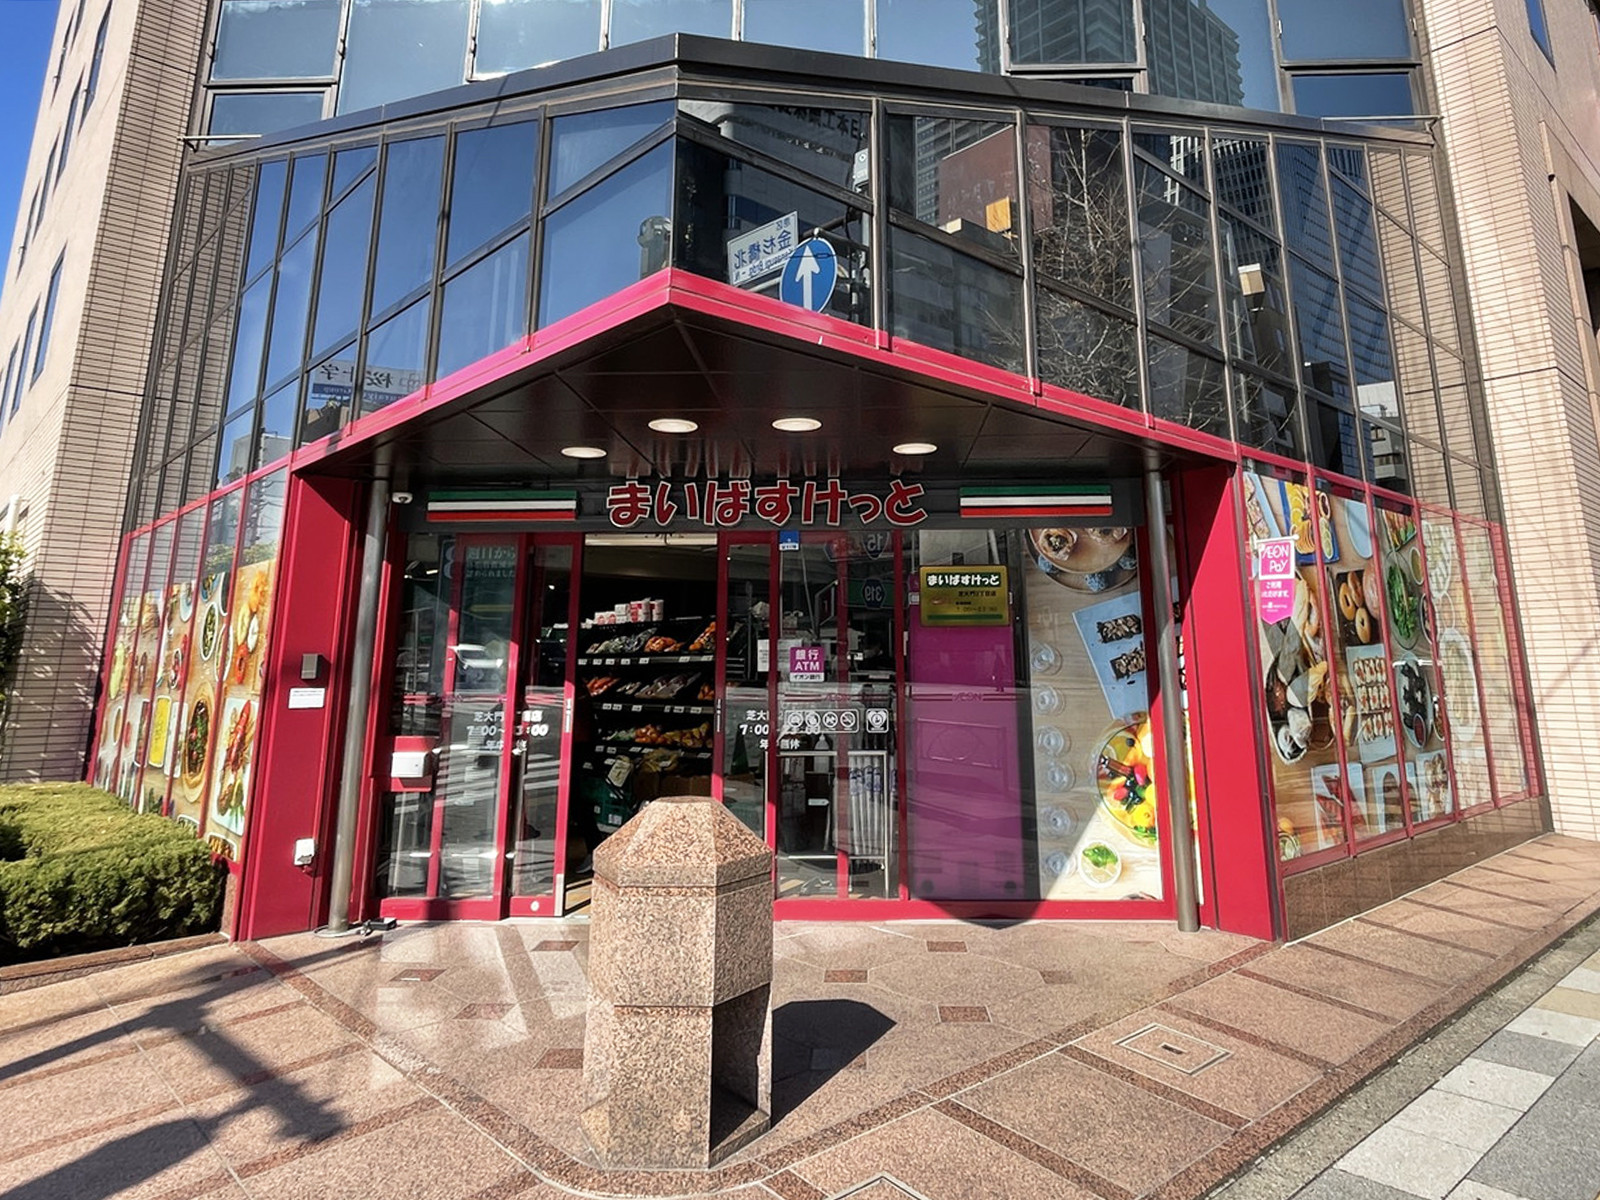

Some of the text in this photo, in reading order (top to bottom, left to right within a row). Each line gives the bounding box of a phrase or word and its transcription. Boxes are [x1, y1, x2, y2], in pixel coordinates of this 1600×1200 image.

[606, 479, 928, 528] まいばすけっと
[927, 574, 1000, 586] まいばすけっと
[795, 649, 819, 660] 銀行
[794, 661, 819, 671] ATM
